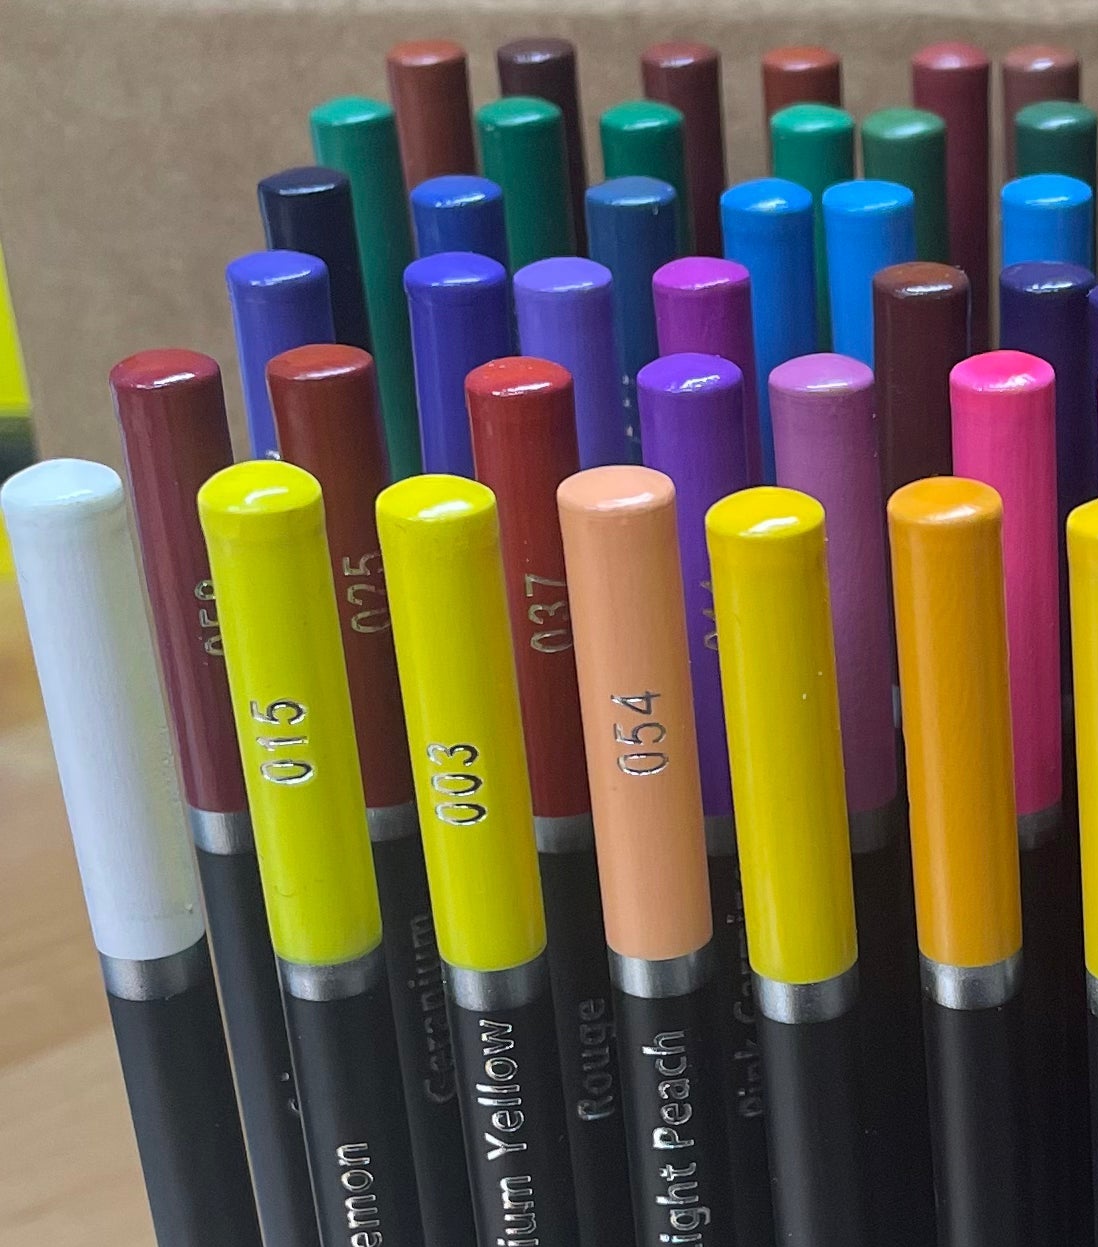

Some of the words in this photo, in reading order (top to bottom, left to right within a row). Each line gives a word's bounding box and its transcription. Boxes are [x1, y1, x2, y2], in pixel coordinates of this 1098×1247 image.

[524, 572, 574, 653] 037
[249, 697, 317, 785] 015
[610, 690, 670, 777] 054
[426, 742, 489, 828] 003
[475, 1018, 527, 1161] Yellow
[577, 998, 617, 1121] Rouge
[641, 1030, 695, 1149] Peach
